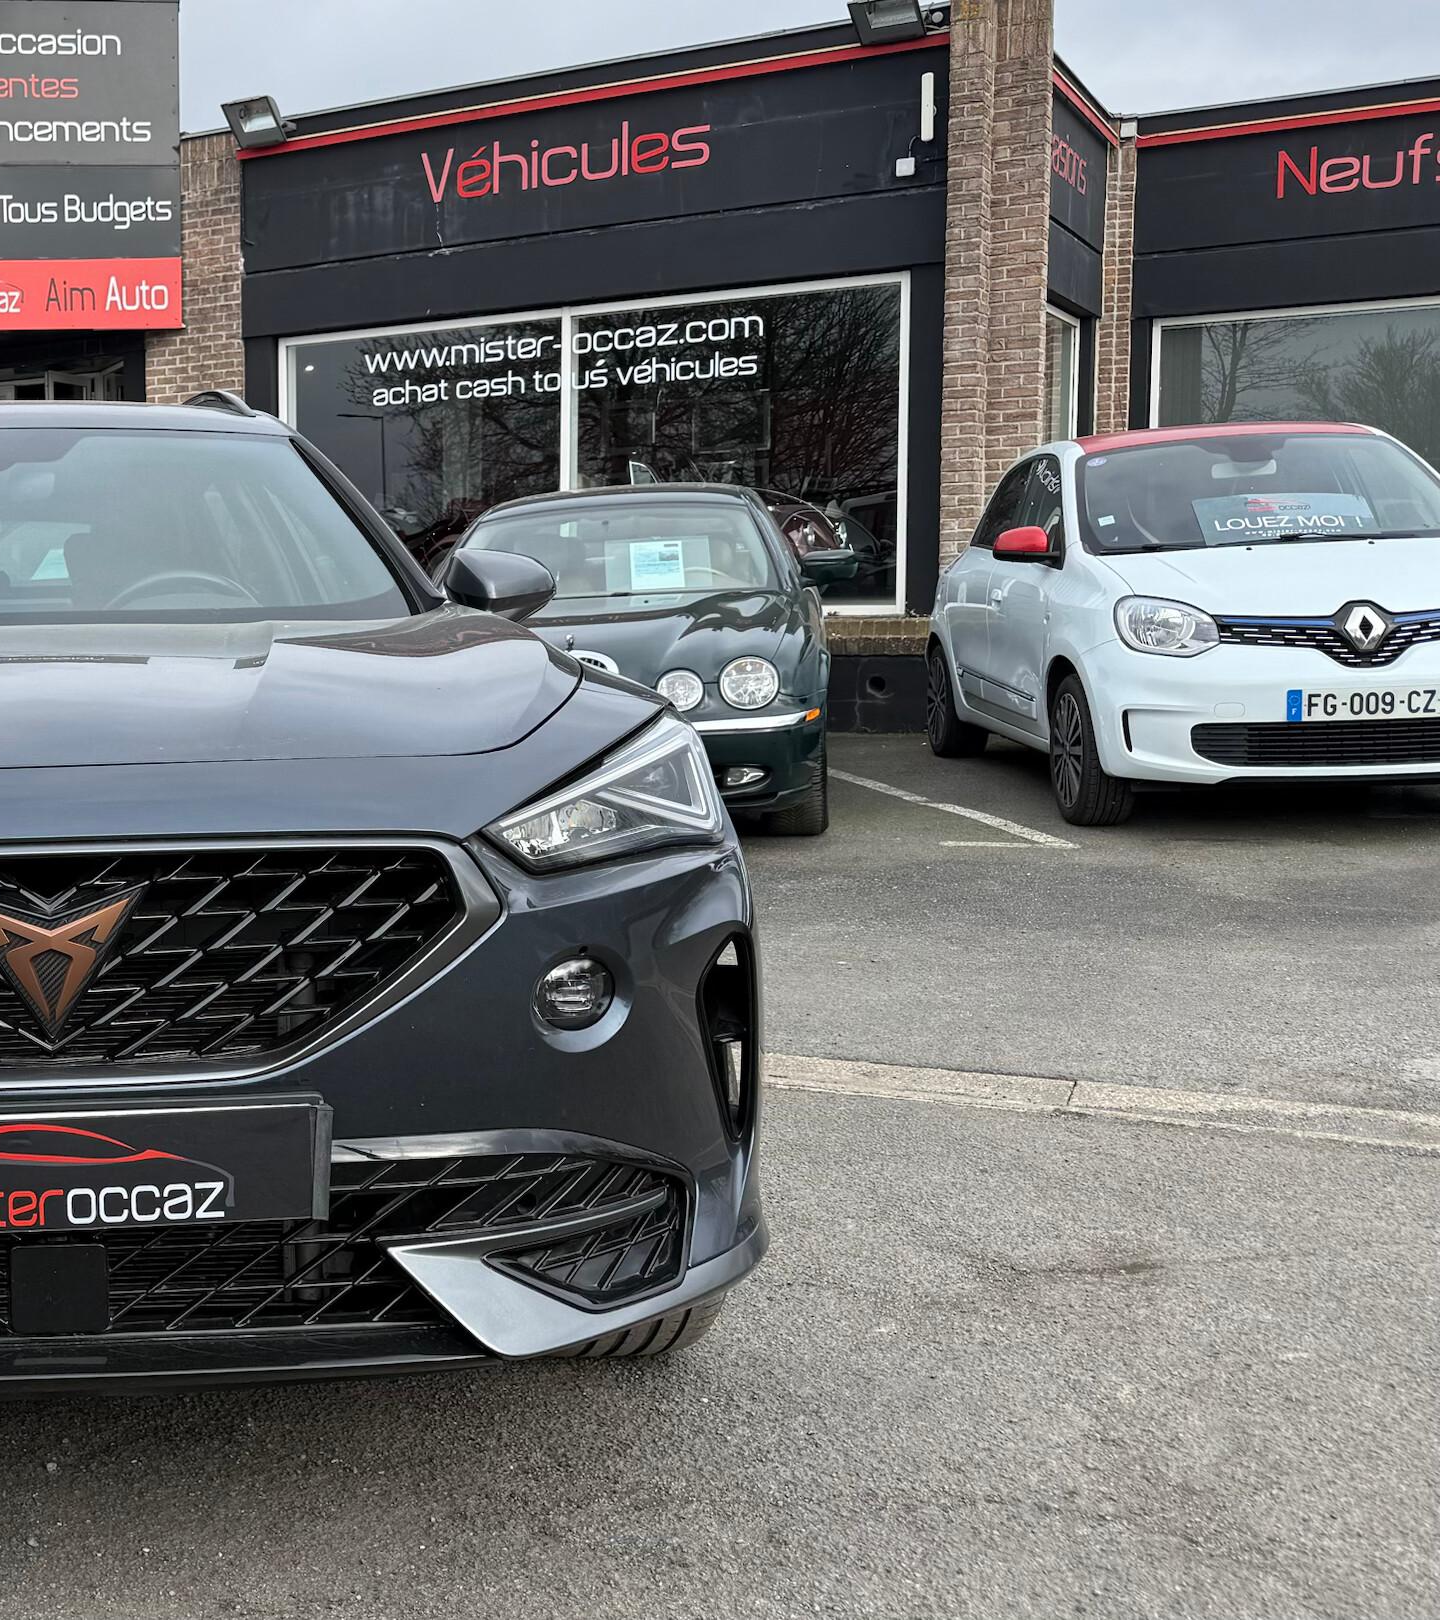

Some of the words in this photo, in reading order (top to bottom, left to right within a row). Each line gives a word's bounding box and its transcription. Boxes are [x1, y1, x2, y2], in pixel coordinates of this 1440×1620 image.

[421, 121, 711, 204] Véhicules
[1276, 132, 1440, 199] Neuf
[65, 194, 172, 229] Budgets
[46, 278, 96, 311] Aim
[106, 276, 168, 312] Auto
[373, 380, 448, 407] achat
[456, 371, 526, 398] cash
[616, 352, 758, 386] véhicules
[1214, 516, 1293, 532] LOUEZ
[1297, 515, 1344, 528] MOI
[1307, 690, 1437, 717] FG-009-CZ
